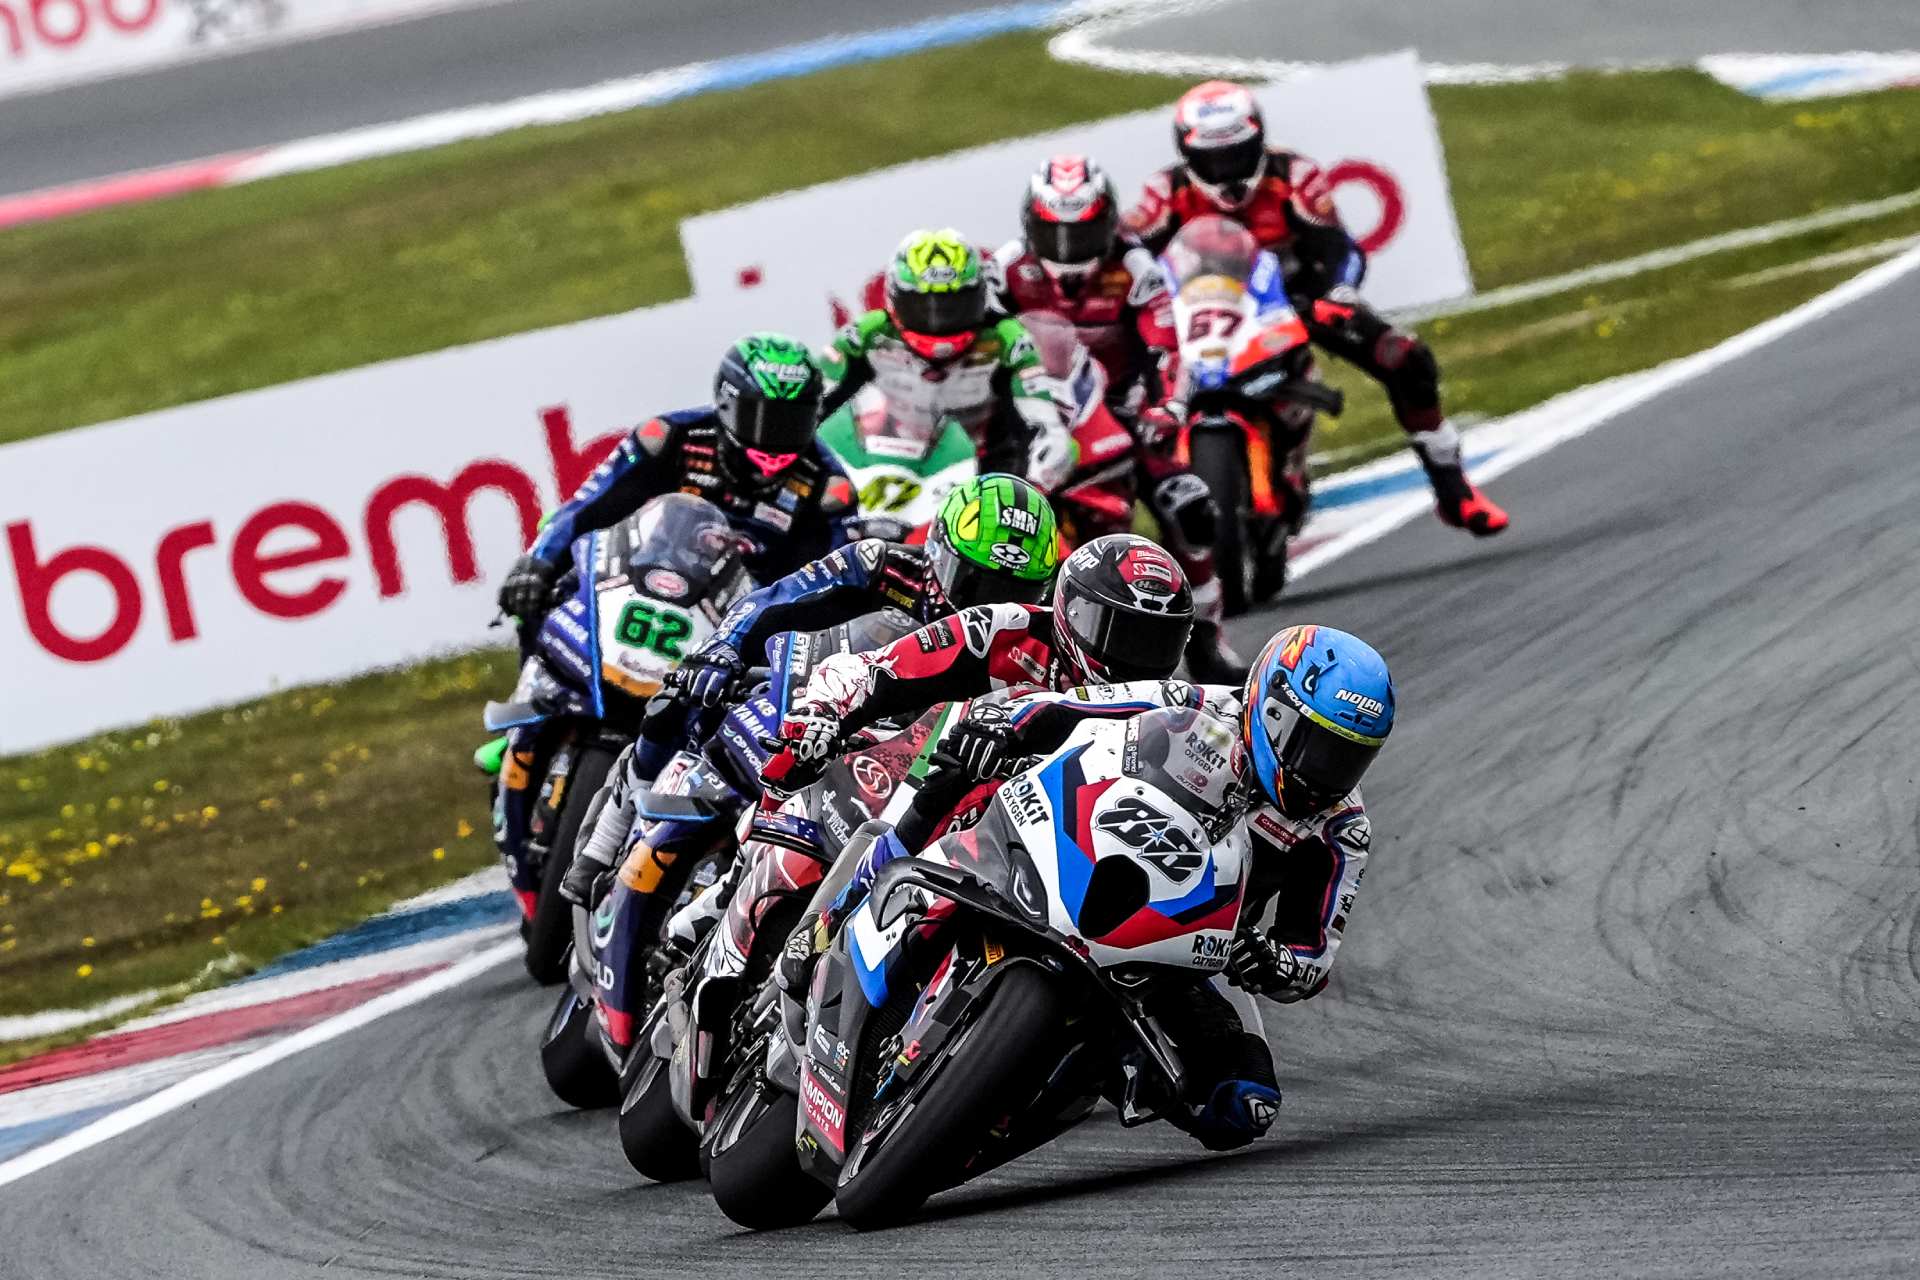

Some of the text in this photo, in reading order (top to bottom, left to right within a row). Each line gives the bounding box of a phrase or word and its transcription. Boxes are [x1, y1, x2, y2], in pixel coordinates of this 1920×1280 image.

[5, 402, 640, 664] bremb
[615, 600, 694, 661] 62
[1334, 689, 1385, 718] NOLAN
[732, 704, 773, 739] YAMAH
[1184, 749, 1215, 774] OXYGEN
[1002, 787, 1027, 828] OXYGEN
[1191, 934, 1231, 956] ROKi
